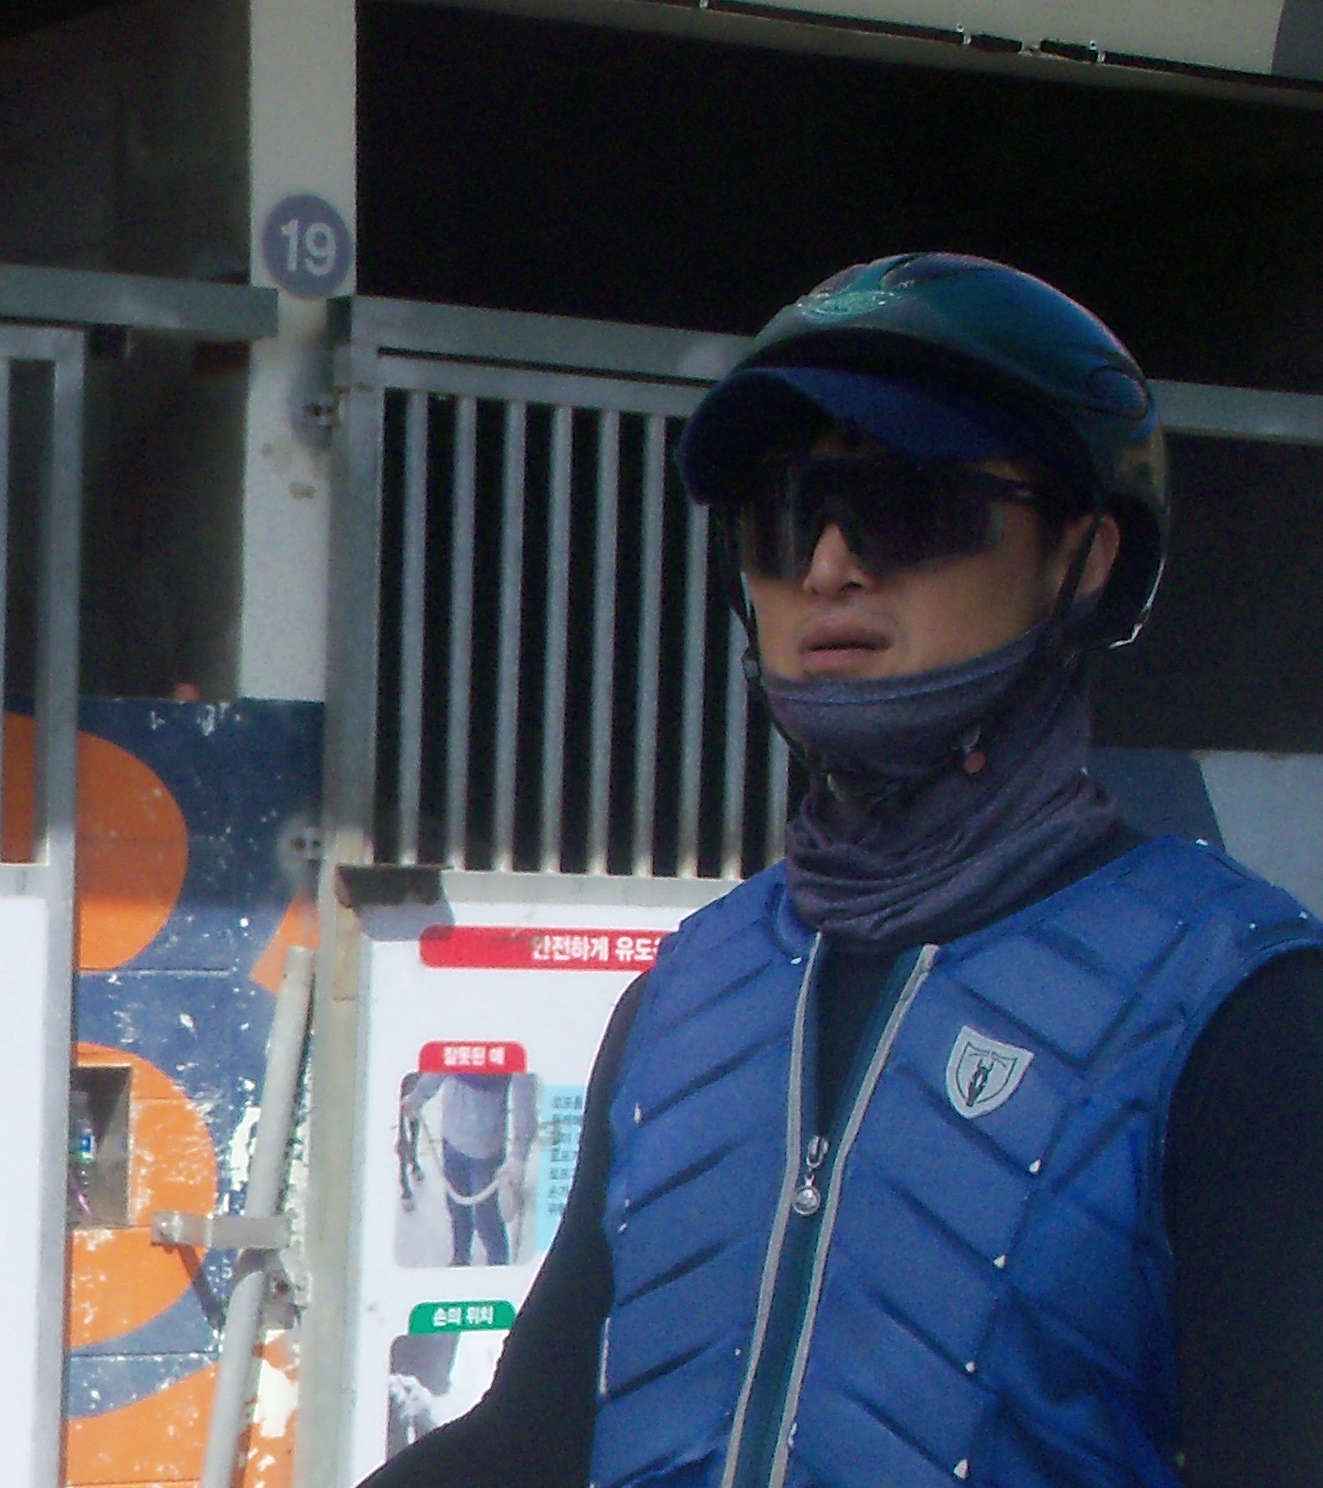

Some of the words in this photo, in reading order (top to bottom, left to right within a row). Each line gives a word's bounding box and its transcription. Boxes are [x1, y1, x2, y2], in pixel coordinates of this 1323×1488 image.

[281, 219, 337, 277] 19
[532, 934, 610, 962] 안전하게
[432, 1307, 463, 1327] 손의
[466, 1305, 494, 1325] 위치
